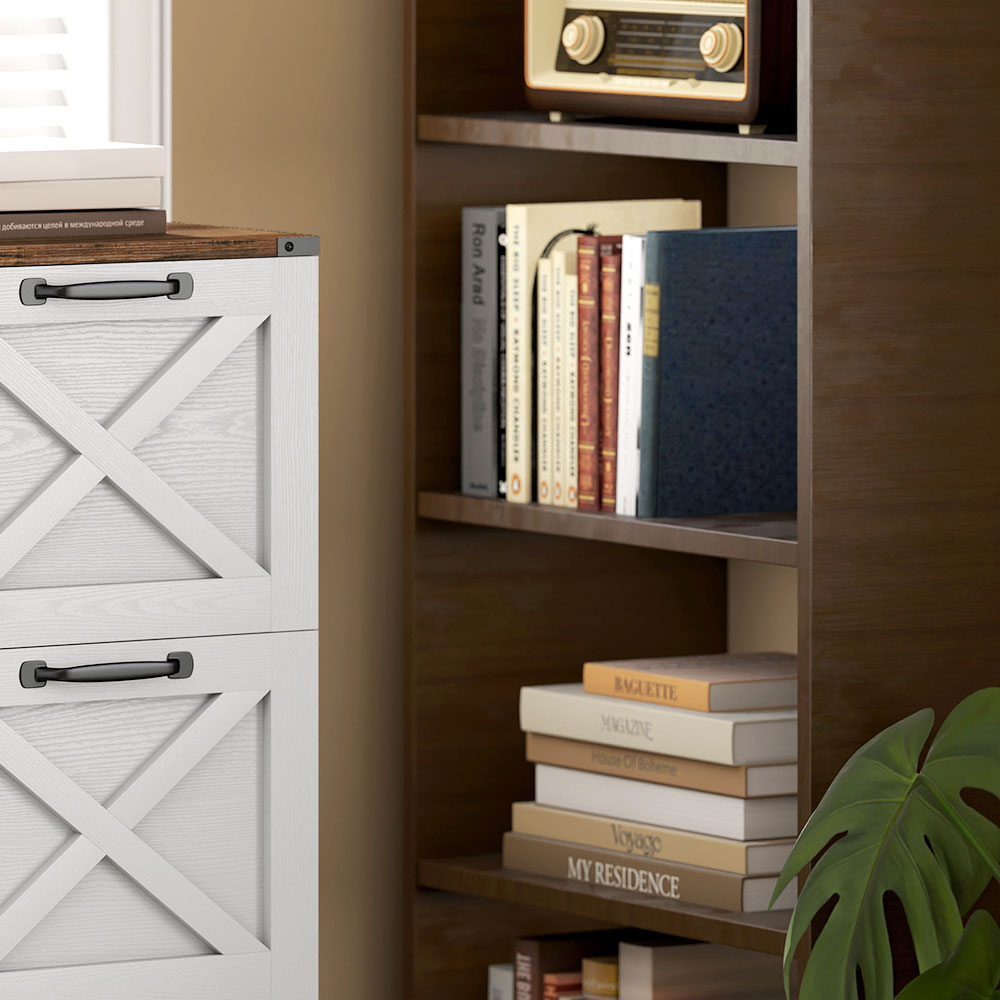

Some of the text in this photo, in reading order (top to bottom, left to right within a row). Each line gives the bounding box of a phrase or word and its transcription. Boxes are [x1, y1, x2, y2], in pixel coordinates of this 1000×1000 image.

[2, 222, 42, 231] добиваются
[43, 221, 63, 230] целей
[70, 219, 124, 229] международной
[125, 219, 145, 228] среде
[472, 223, 486, 258] Ron
[472, 263, 486, 306] Arad
[614, 676, 678, 701] BAGUETTE
[591, 748, 621, 768] House
[568, 856, 680, 899] MY RESIDENCE
